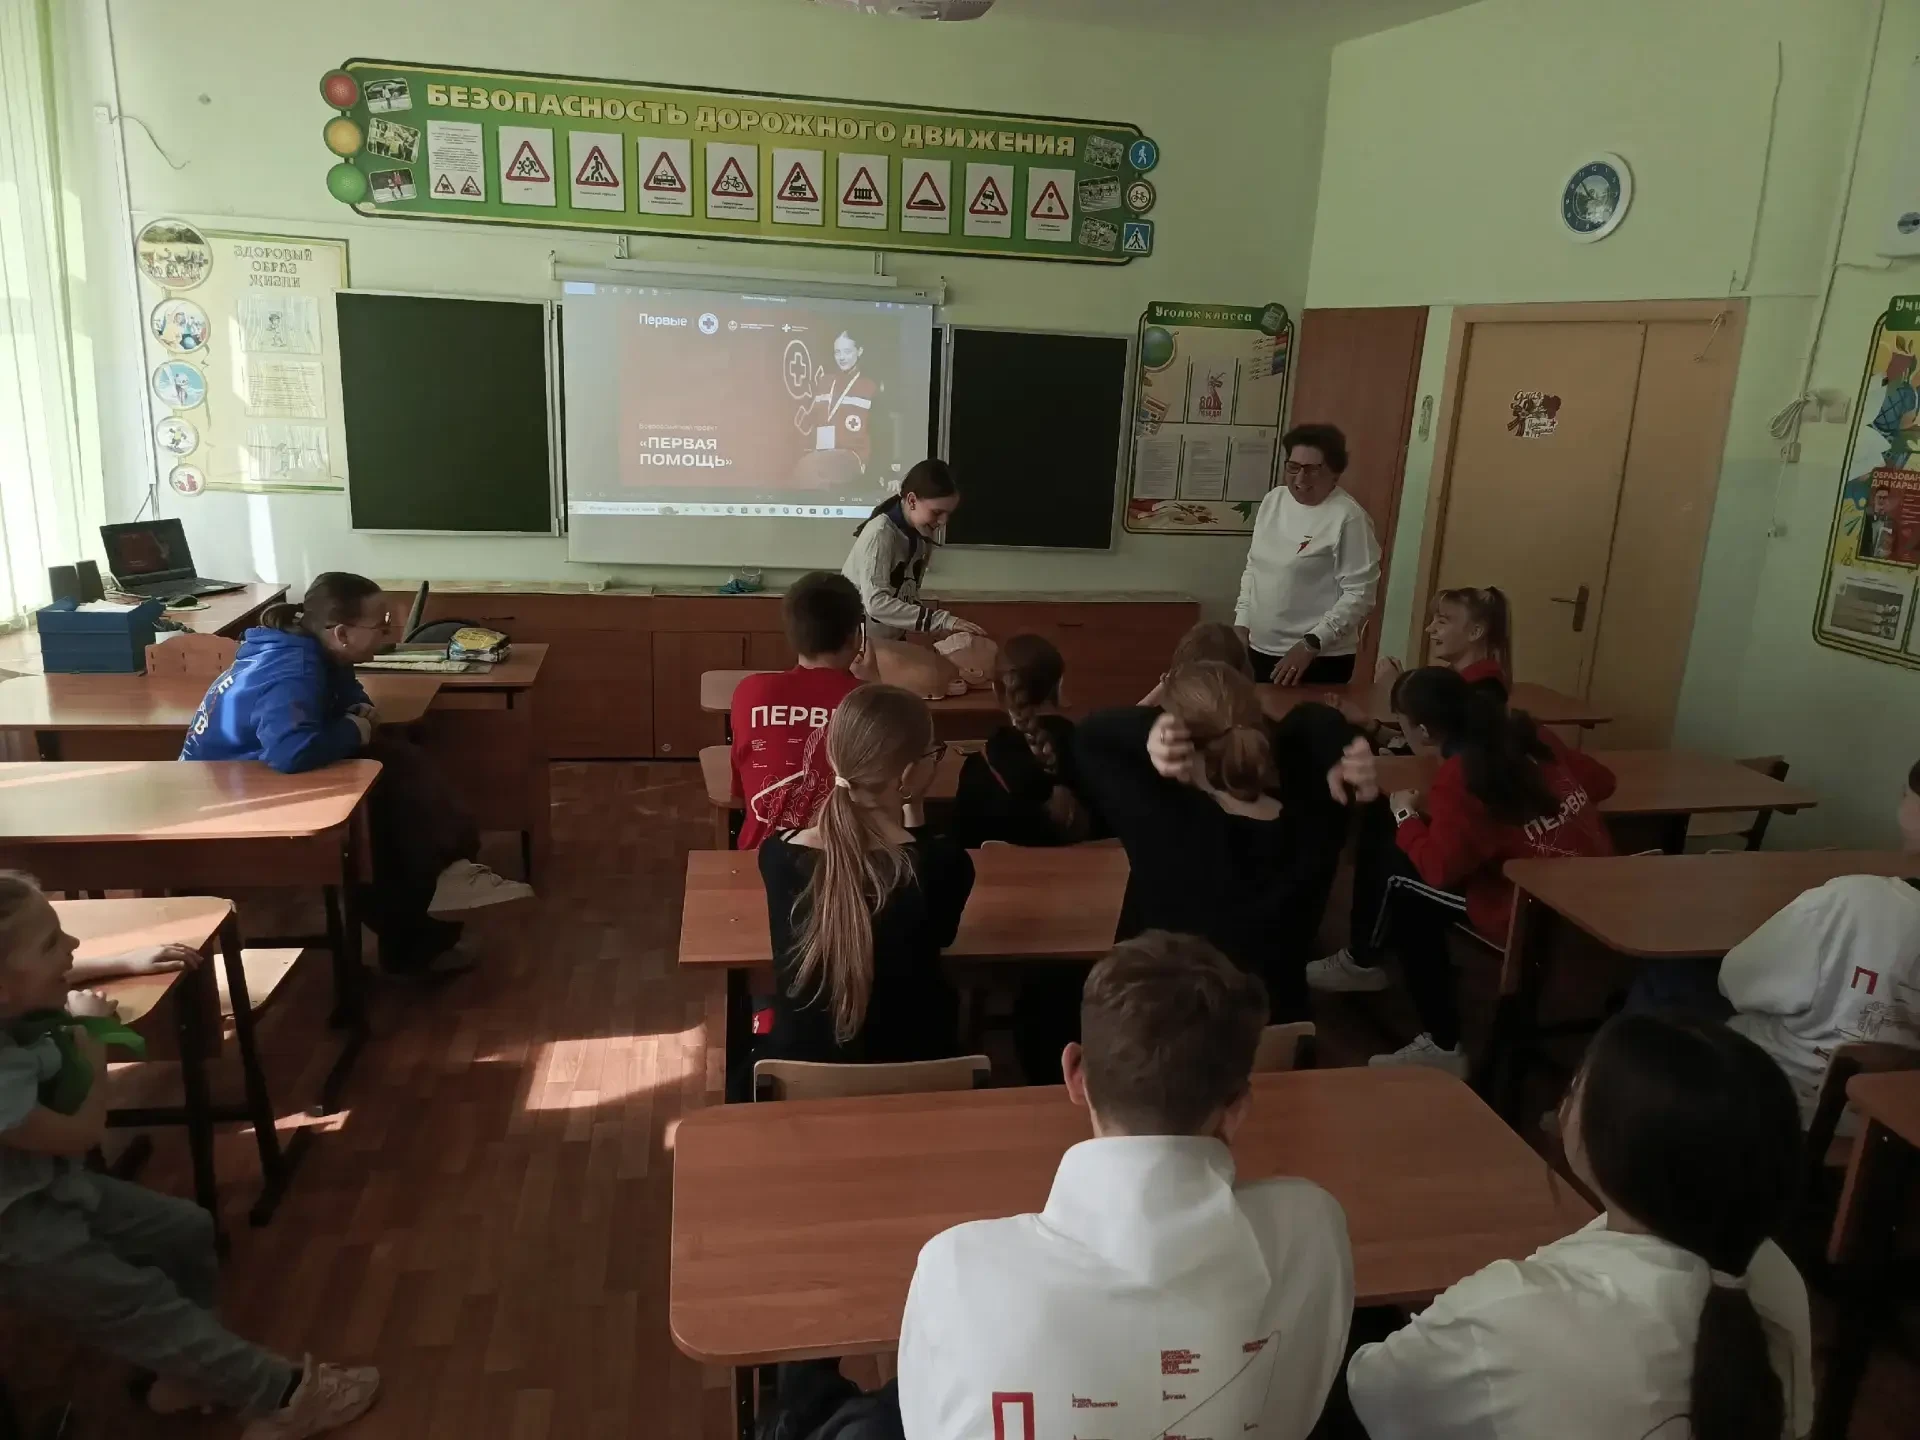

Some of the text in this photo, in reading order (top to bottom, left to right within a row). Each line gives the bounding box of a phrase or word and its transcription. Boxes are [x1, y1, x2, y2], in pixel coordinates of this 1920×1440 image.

[427, 84, 1075, 157] БЕЗОПАСНОСТЬ ДОРОЖНОГО ДВИЖЕНИЯ
[233, 245, 313, 262] ЗДОРОВЫЙ
[251, 260, 297, 274] ОБРАЗ
[249, 274, 301, 288] ЖИЗНИ
[639, 313, 688, 328] Первые
[1155, 305, 1252, 322] Уголок класса
[640, 436, 717, 450] «ПЕРВАЯ
[640, 453, 733, 468] ПОМОЩЬ»
[751, 705, 837, 728] ПЕРВ
